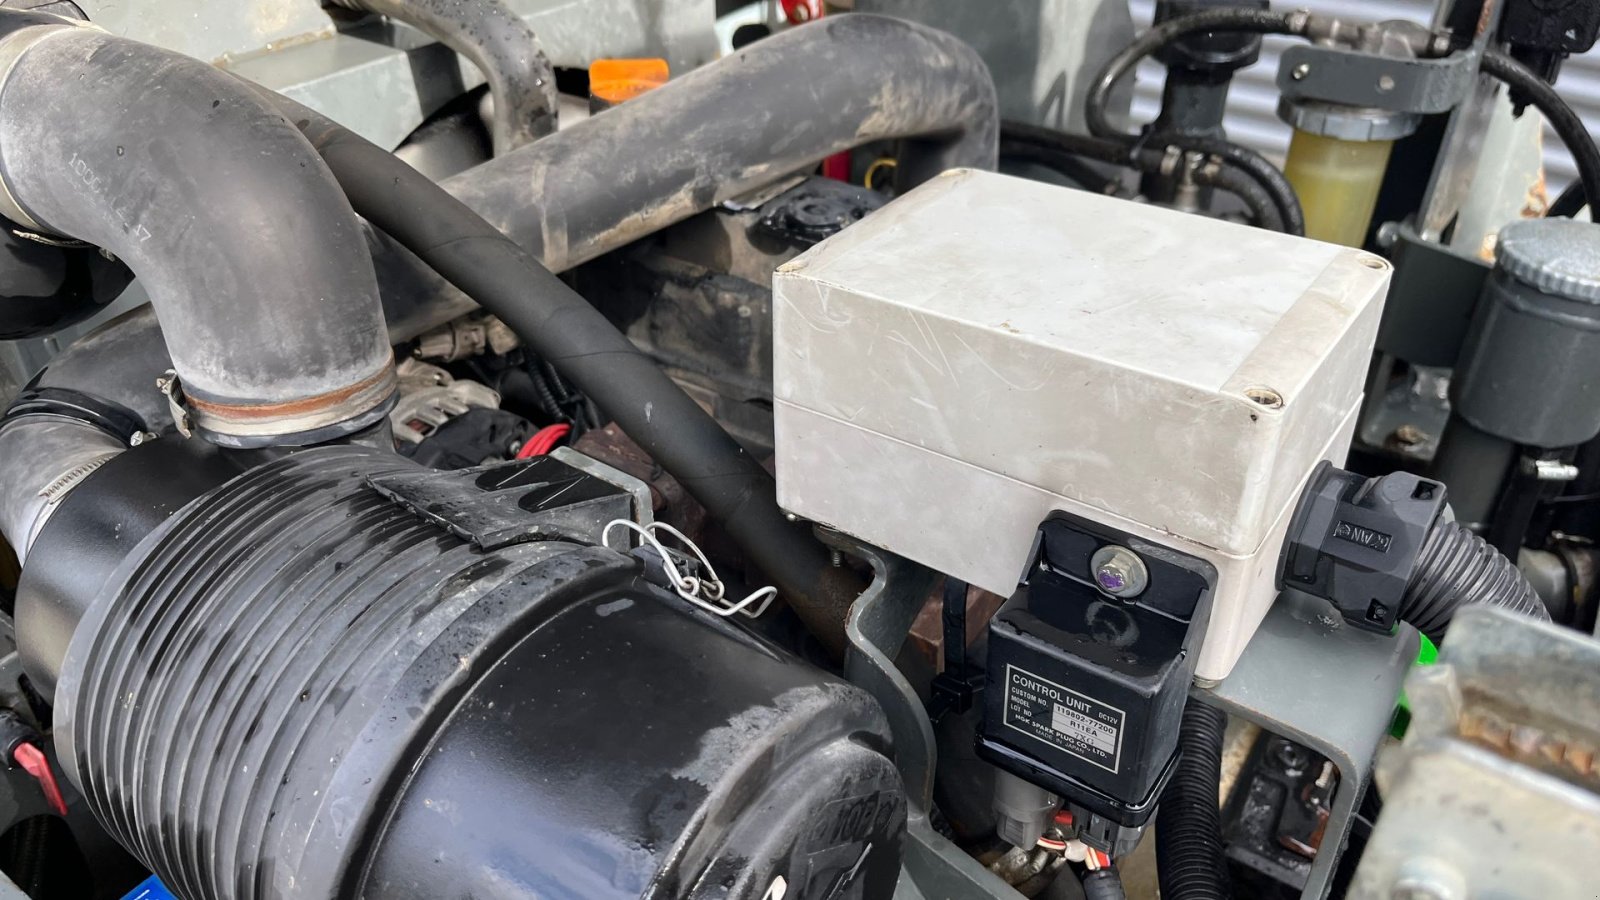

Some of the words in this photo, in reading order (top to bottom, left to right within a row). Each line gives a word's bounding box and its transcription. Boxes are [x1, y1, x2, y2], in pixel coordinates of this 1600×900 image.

[1010, 703, 1020, 712] LOT
[1011, 687, 1037, 701] CUSTOM
[1056, 706, 1114, 735] 119802-77200
[1011, 695, 1031, 708] MODEL
[1070, 720, 1098, 737] R11EA
[1012, 674, 1063, 703] CONTROL
[1066, 696, 1092, 713] UNIT
[1098, 712, 1118, 725] DC12V
[1032, 721, 1054, 735] SPARK
[1055, 729, 1075, 743] PLUG
[1092, 747, 1108, 759] LTD.
[1035, 729, 1053, 740] MADE
[1055, 736, 1063, 744] IN
[1064, 741, 1085, 754] JAPAN
